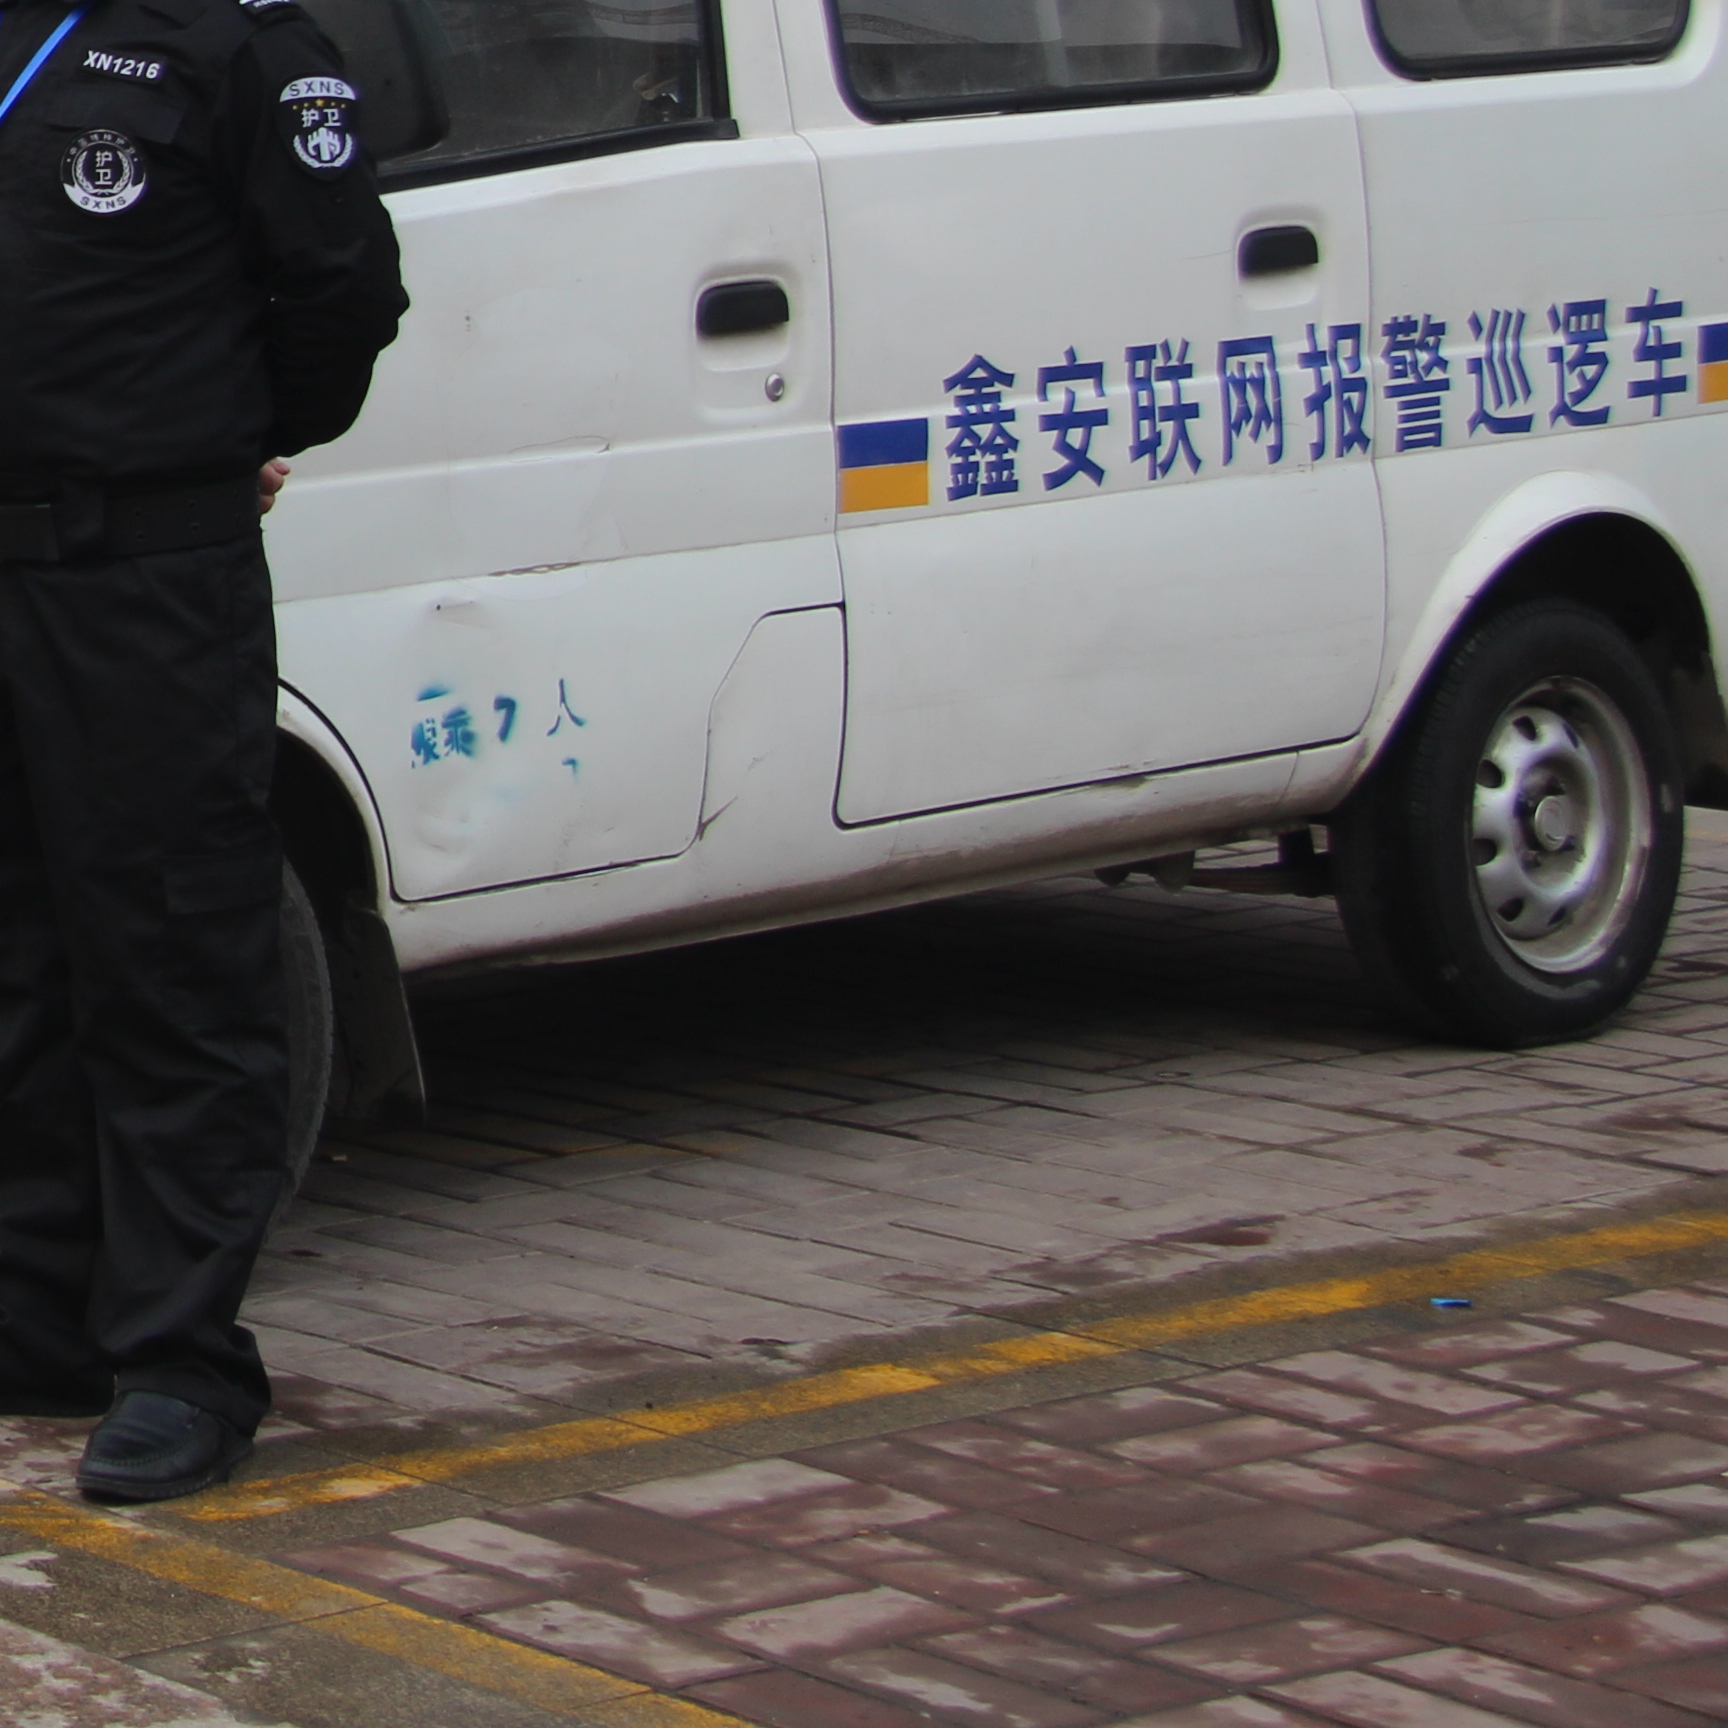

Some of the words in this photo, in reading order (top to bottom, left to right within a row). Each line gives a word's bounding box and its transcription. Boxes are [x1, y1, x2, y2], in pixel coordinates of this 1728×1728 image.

[83, 50, 161, 80] XN1216
[288, 79, 346, 98] SXNS
[300, 108, 342, 128] 护卫
[95, 150, 113, 186] 护卫
[79, 196, 126, 209] SXNS
[944, 288, 1689, 504] 鑫安联网报警巡逻车
